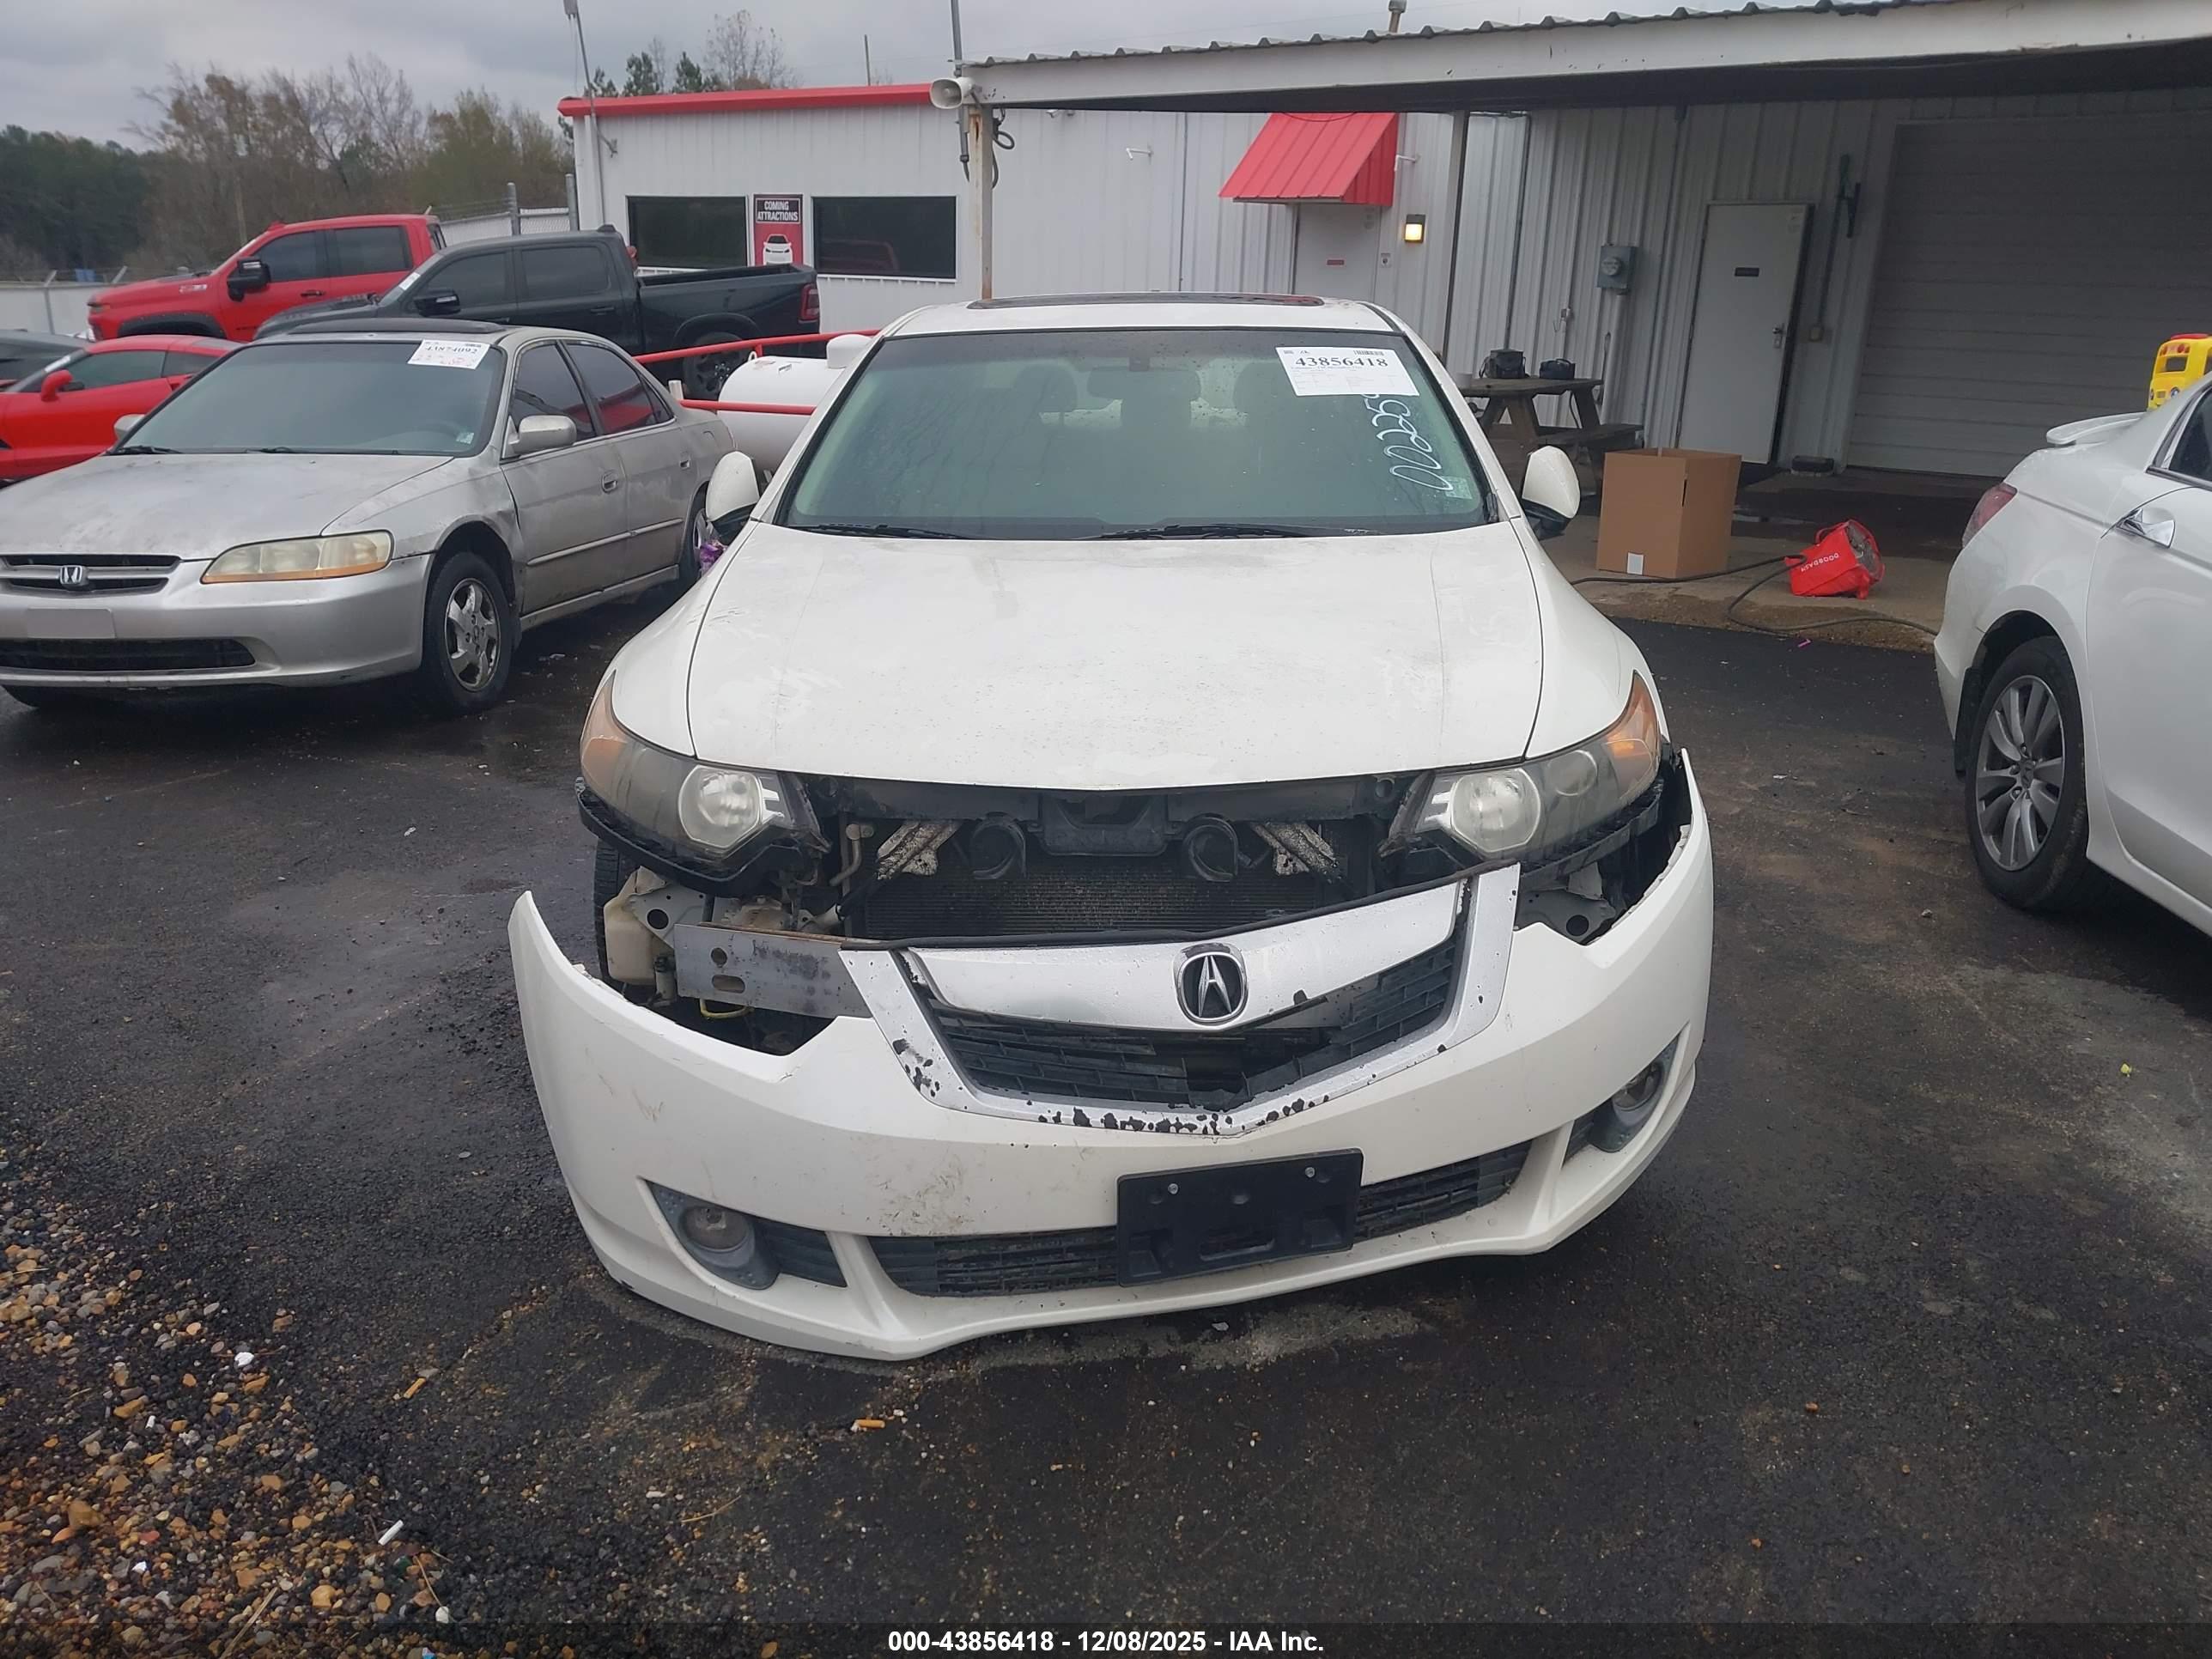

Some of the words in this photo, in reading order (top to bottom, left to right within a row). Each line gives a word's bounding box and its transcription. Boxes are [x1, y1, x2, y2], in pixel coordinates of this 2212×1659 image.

[763, 200, 789, 210] COMING
[757, 211, 799, 221] ATTRACTIONS
[1295, 356, 1389, 368] 43856418
